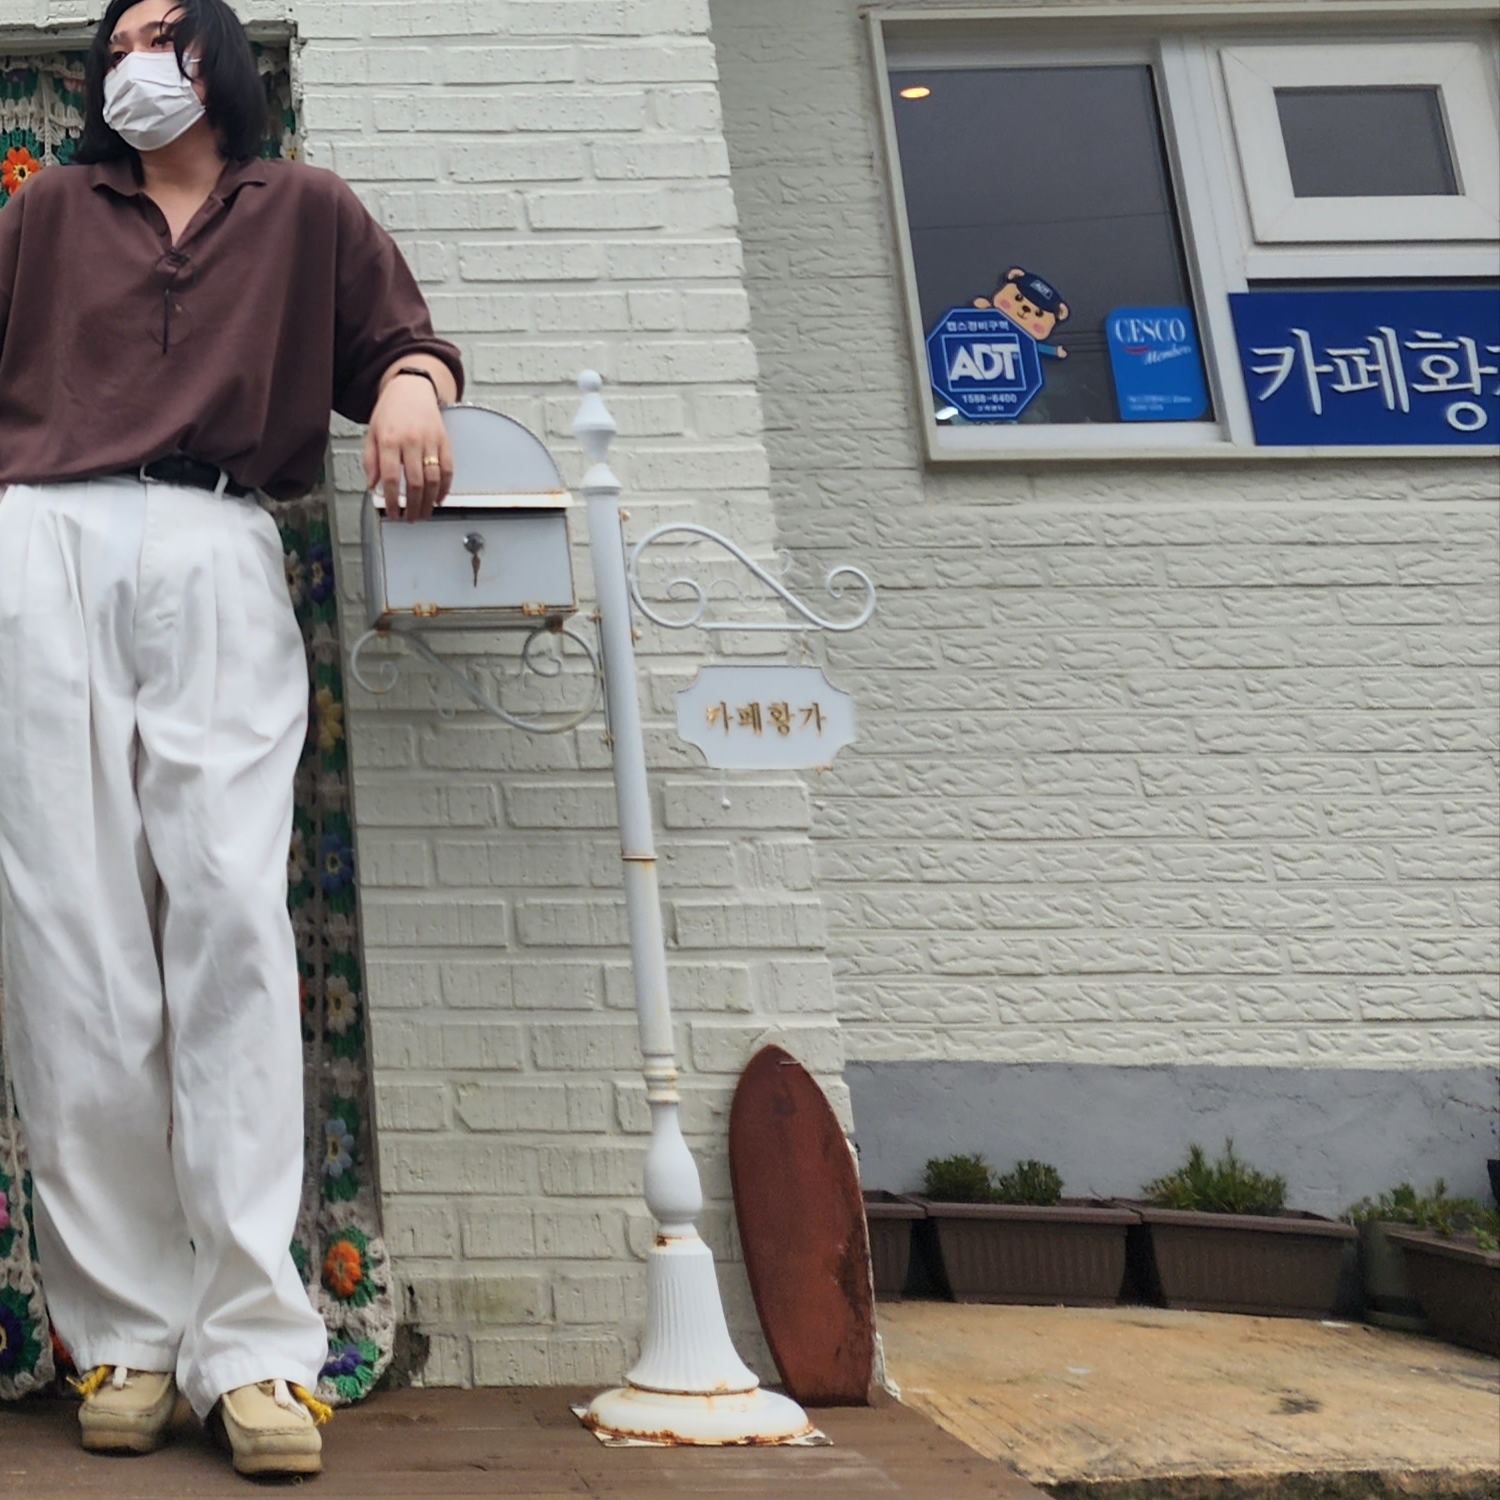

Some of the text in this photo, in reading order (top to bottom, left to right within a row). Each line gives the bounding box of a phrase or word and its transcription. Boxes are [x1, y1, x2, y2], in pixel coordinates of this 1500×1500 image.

[1115, 318, 1186, 343] CESCO
[949, 343, 1020, 381] ADT
[1250, 326, 1500, 432] 카페황
